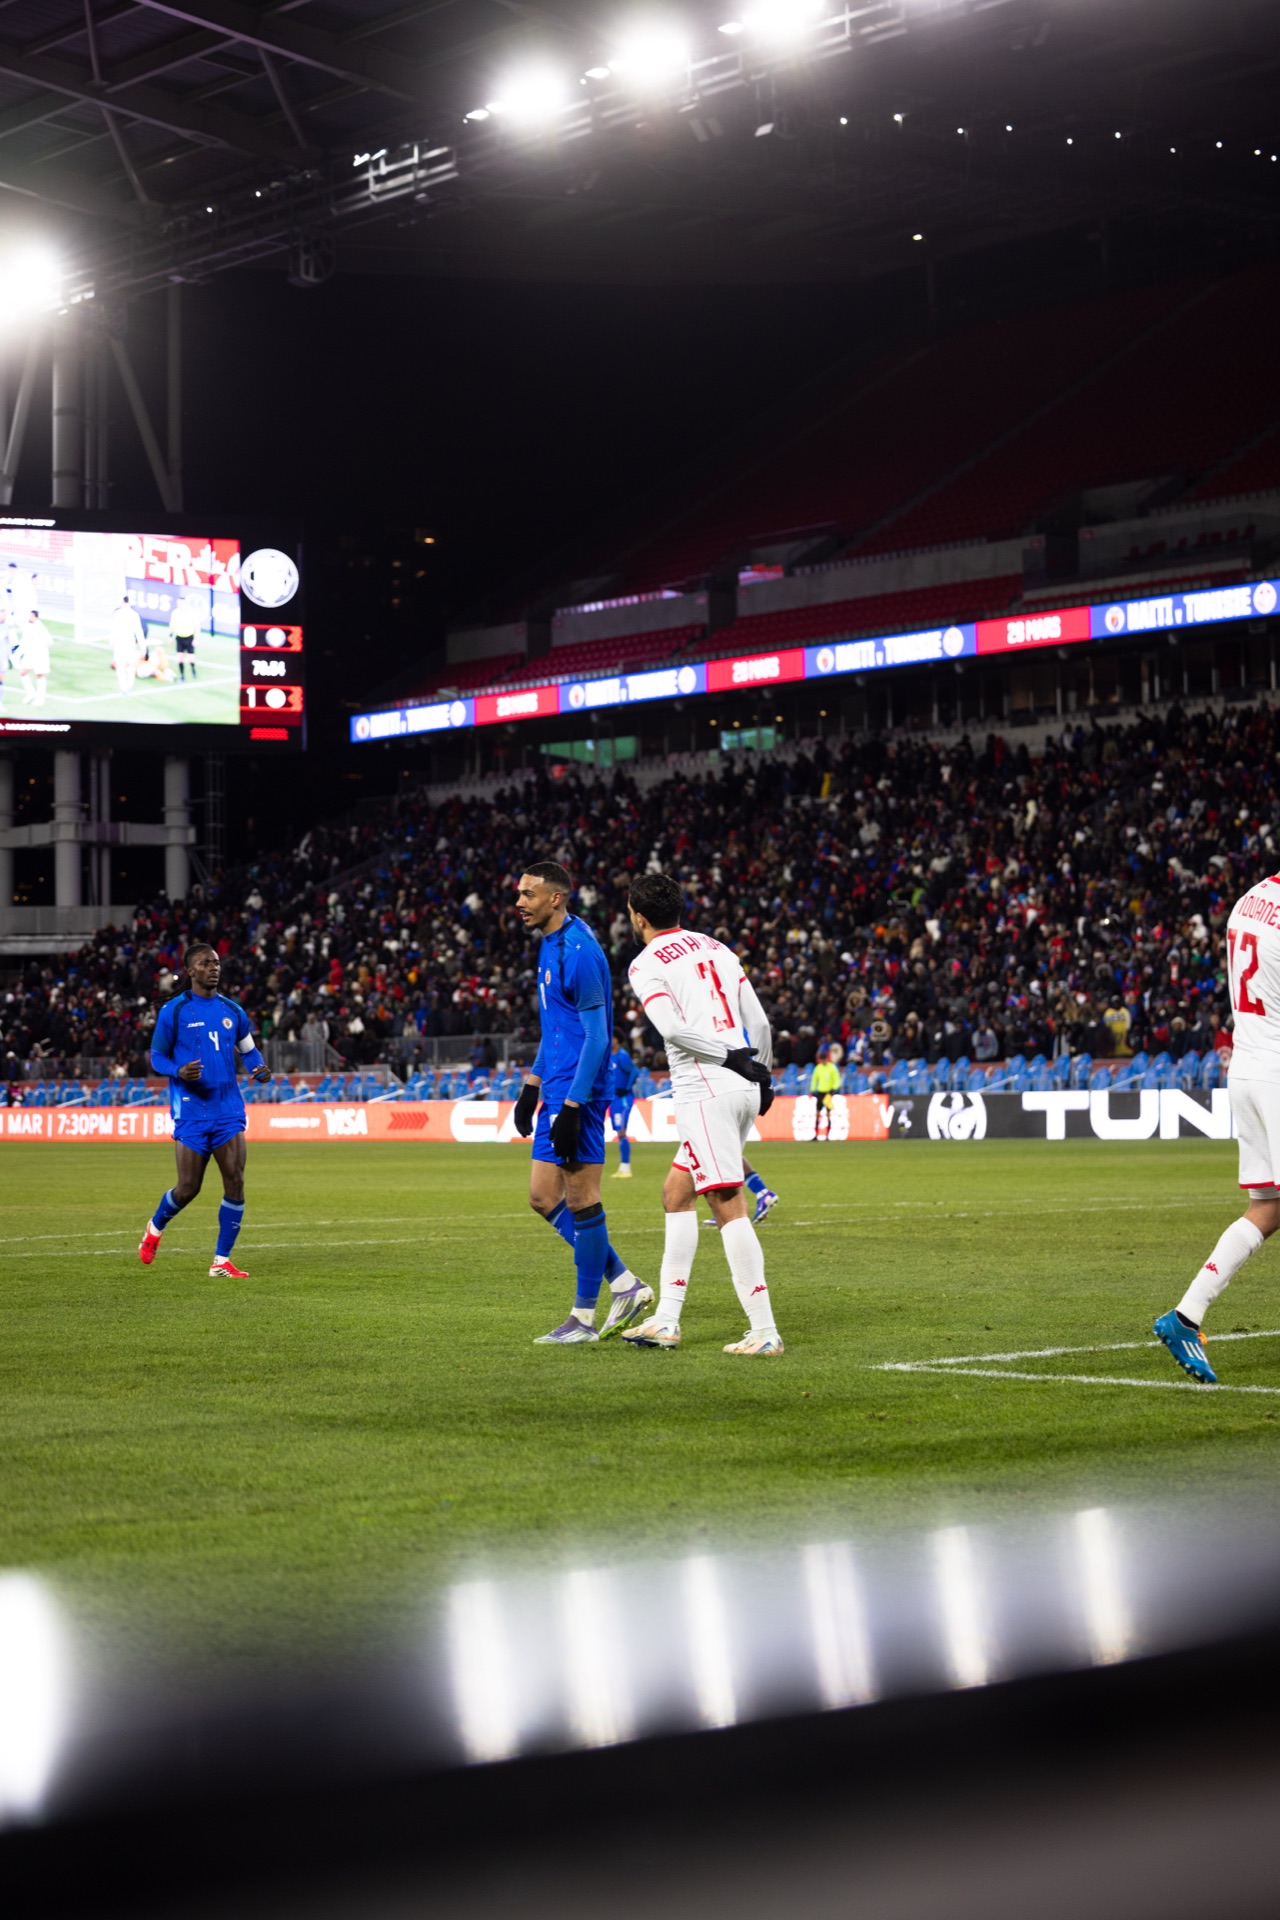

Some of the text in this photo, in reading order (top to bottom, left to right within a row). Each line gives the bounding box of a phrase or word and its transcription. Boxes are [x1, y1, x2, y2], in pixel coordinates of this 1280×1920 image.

[1127, 598, 1173, 631] HAITI
[1184, 587, 1252, 622] TUNISIE
[246, 686, 256, 708] 1
[653, 942, 689, 965] BEN
[1226, 929, 1266, 1017] 12
[694, 959, 736, 1033] 3
[208, 1030, 220, 1051] 4
[7, 1113, 43, 1135] MAR
[57, 1112, 113, 1135] 7:30PM
[117, 1112, 139, 1135] ET
[323, 1107, 369, 1136] VISA
[682, 1140, 701, 1172] 3
